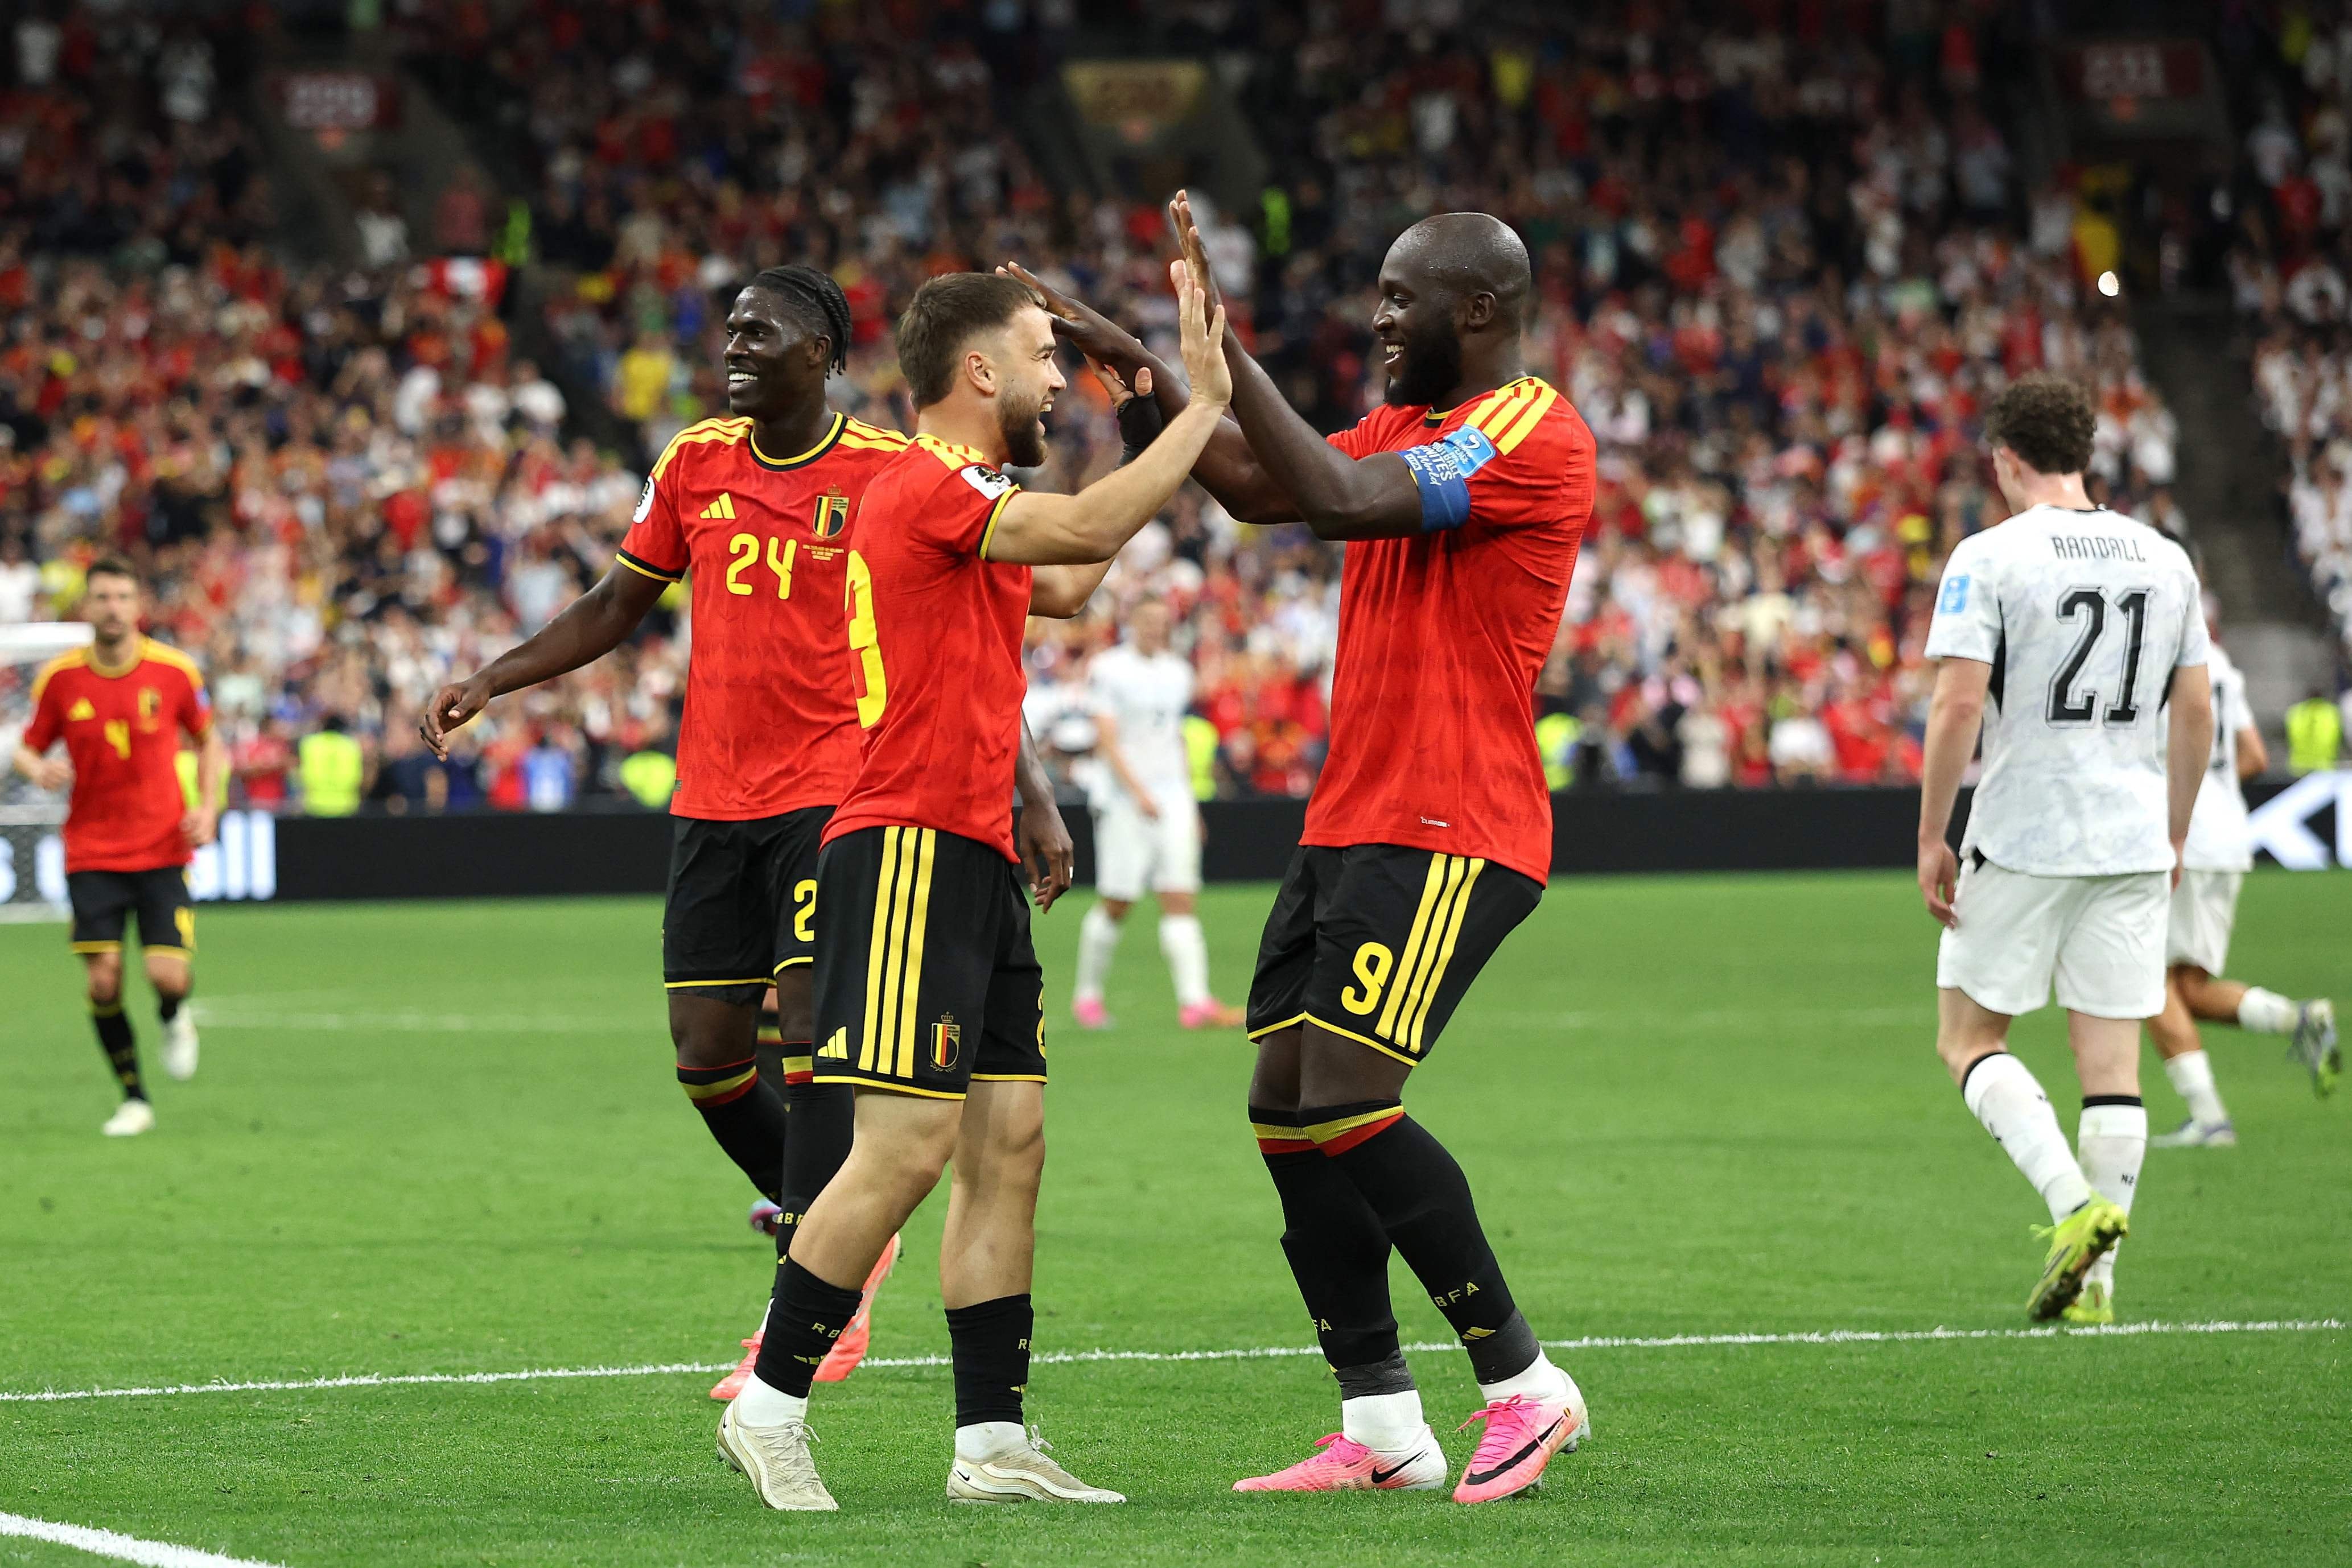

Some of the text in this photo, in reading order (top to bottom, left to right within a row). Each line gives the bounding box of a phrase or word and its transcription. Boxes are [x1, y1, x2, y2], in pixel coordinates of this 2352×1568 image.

[726, 533, 797, 600] 24
[2050, 536, 2147, 562] RANDALL
[2045, 585, 2155, 729] 21
[104, 719, 131, 760] 4
[1341, 942, 1393, 1015] 9
